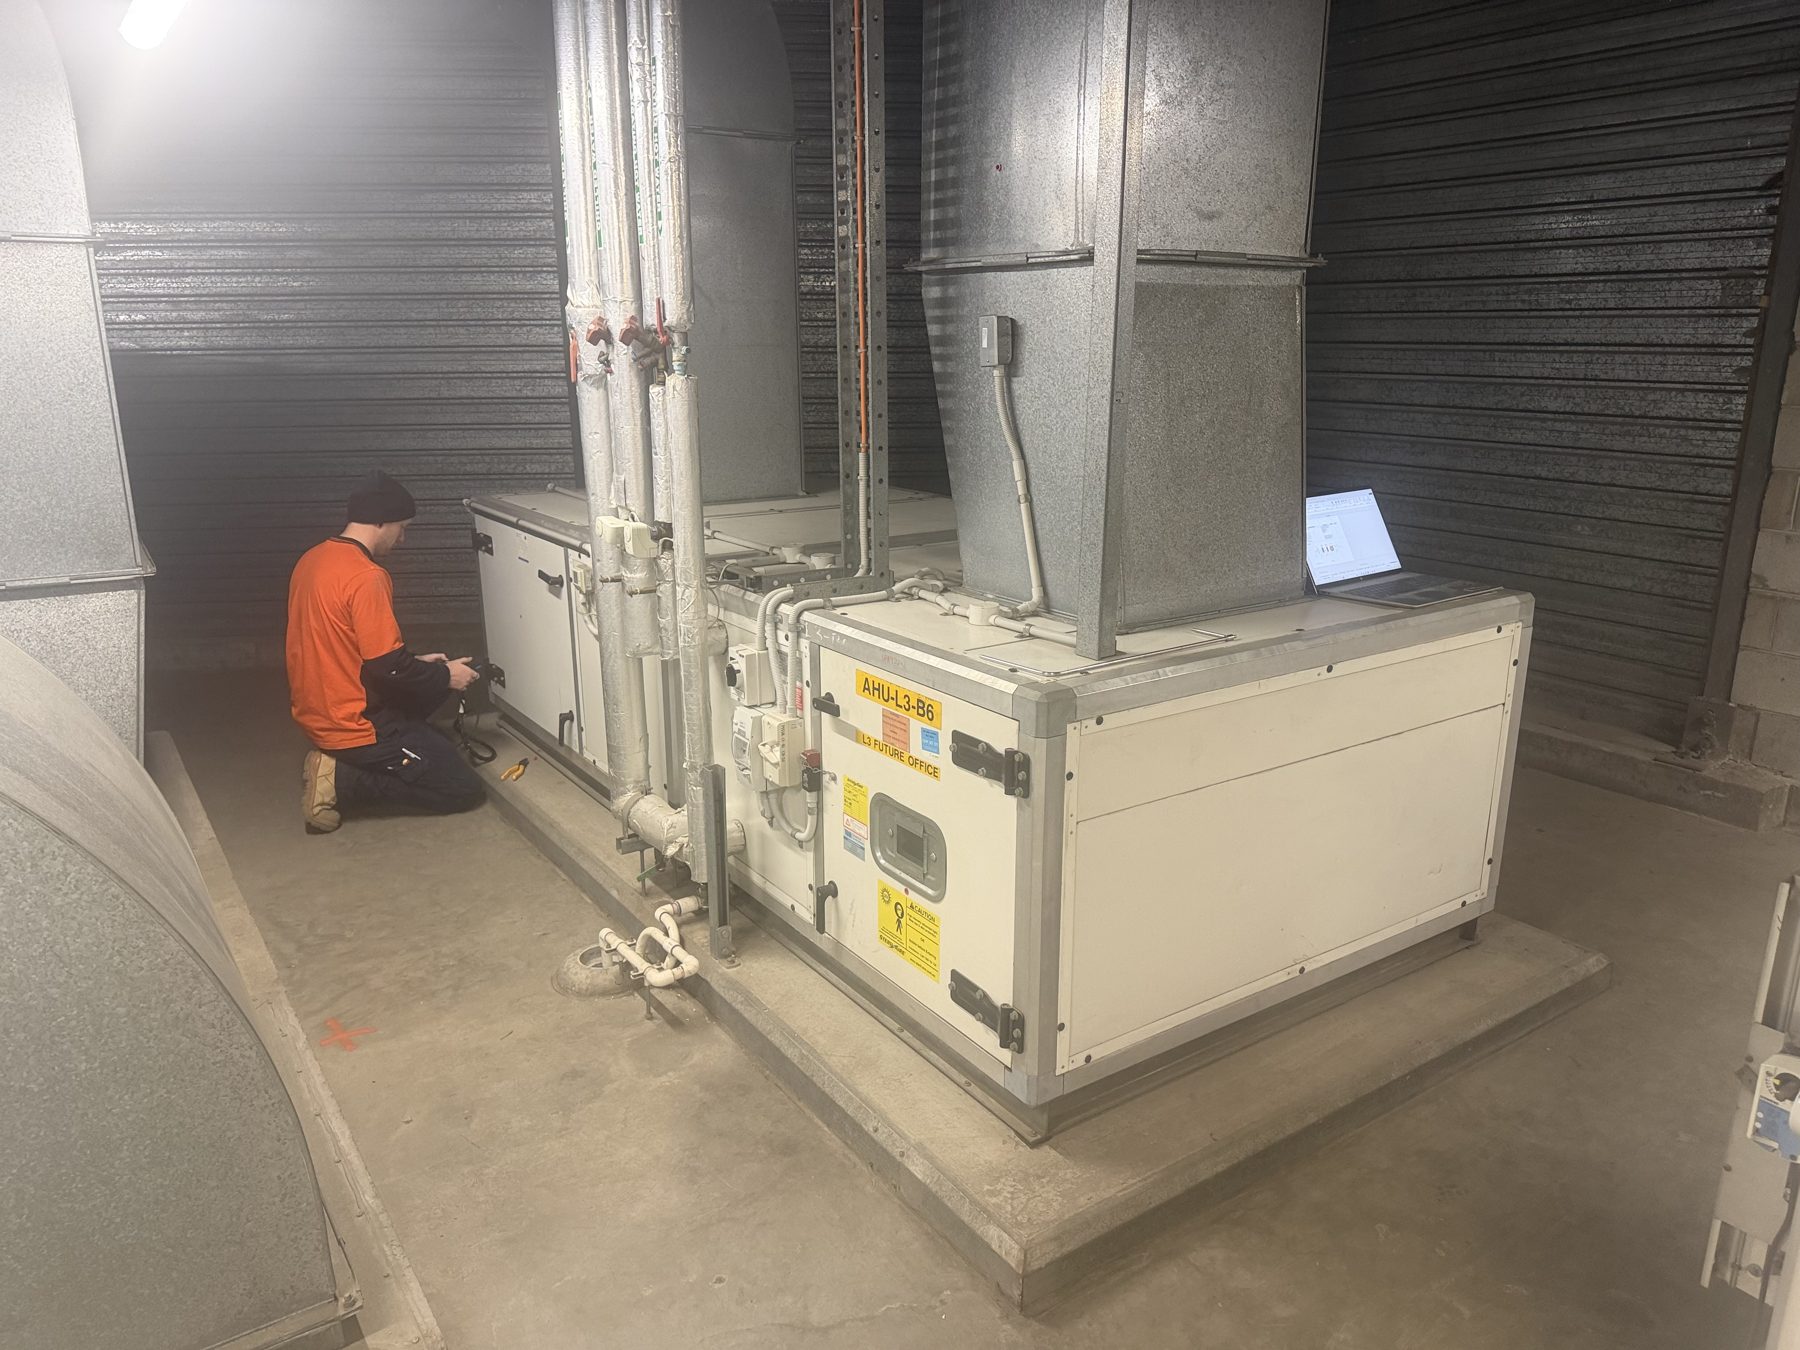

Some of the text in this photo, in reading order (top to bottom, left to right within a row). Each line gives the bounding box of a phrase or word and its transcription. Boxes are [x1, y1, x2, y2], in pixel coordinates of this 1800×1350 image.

[635, 191, 643, 236] WATER
[862, 677, 934, 721] AHU-L3-B6
[862, 734, 939, 778] L3 FUTURE OFFICE
[914, 905, 936, 923] CAUTION
